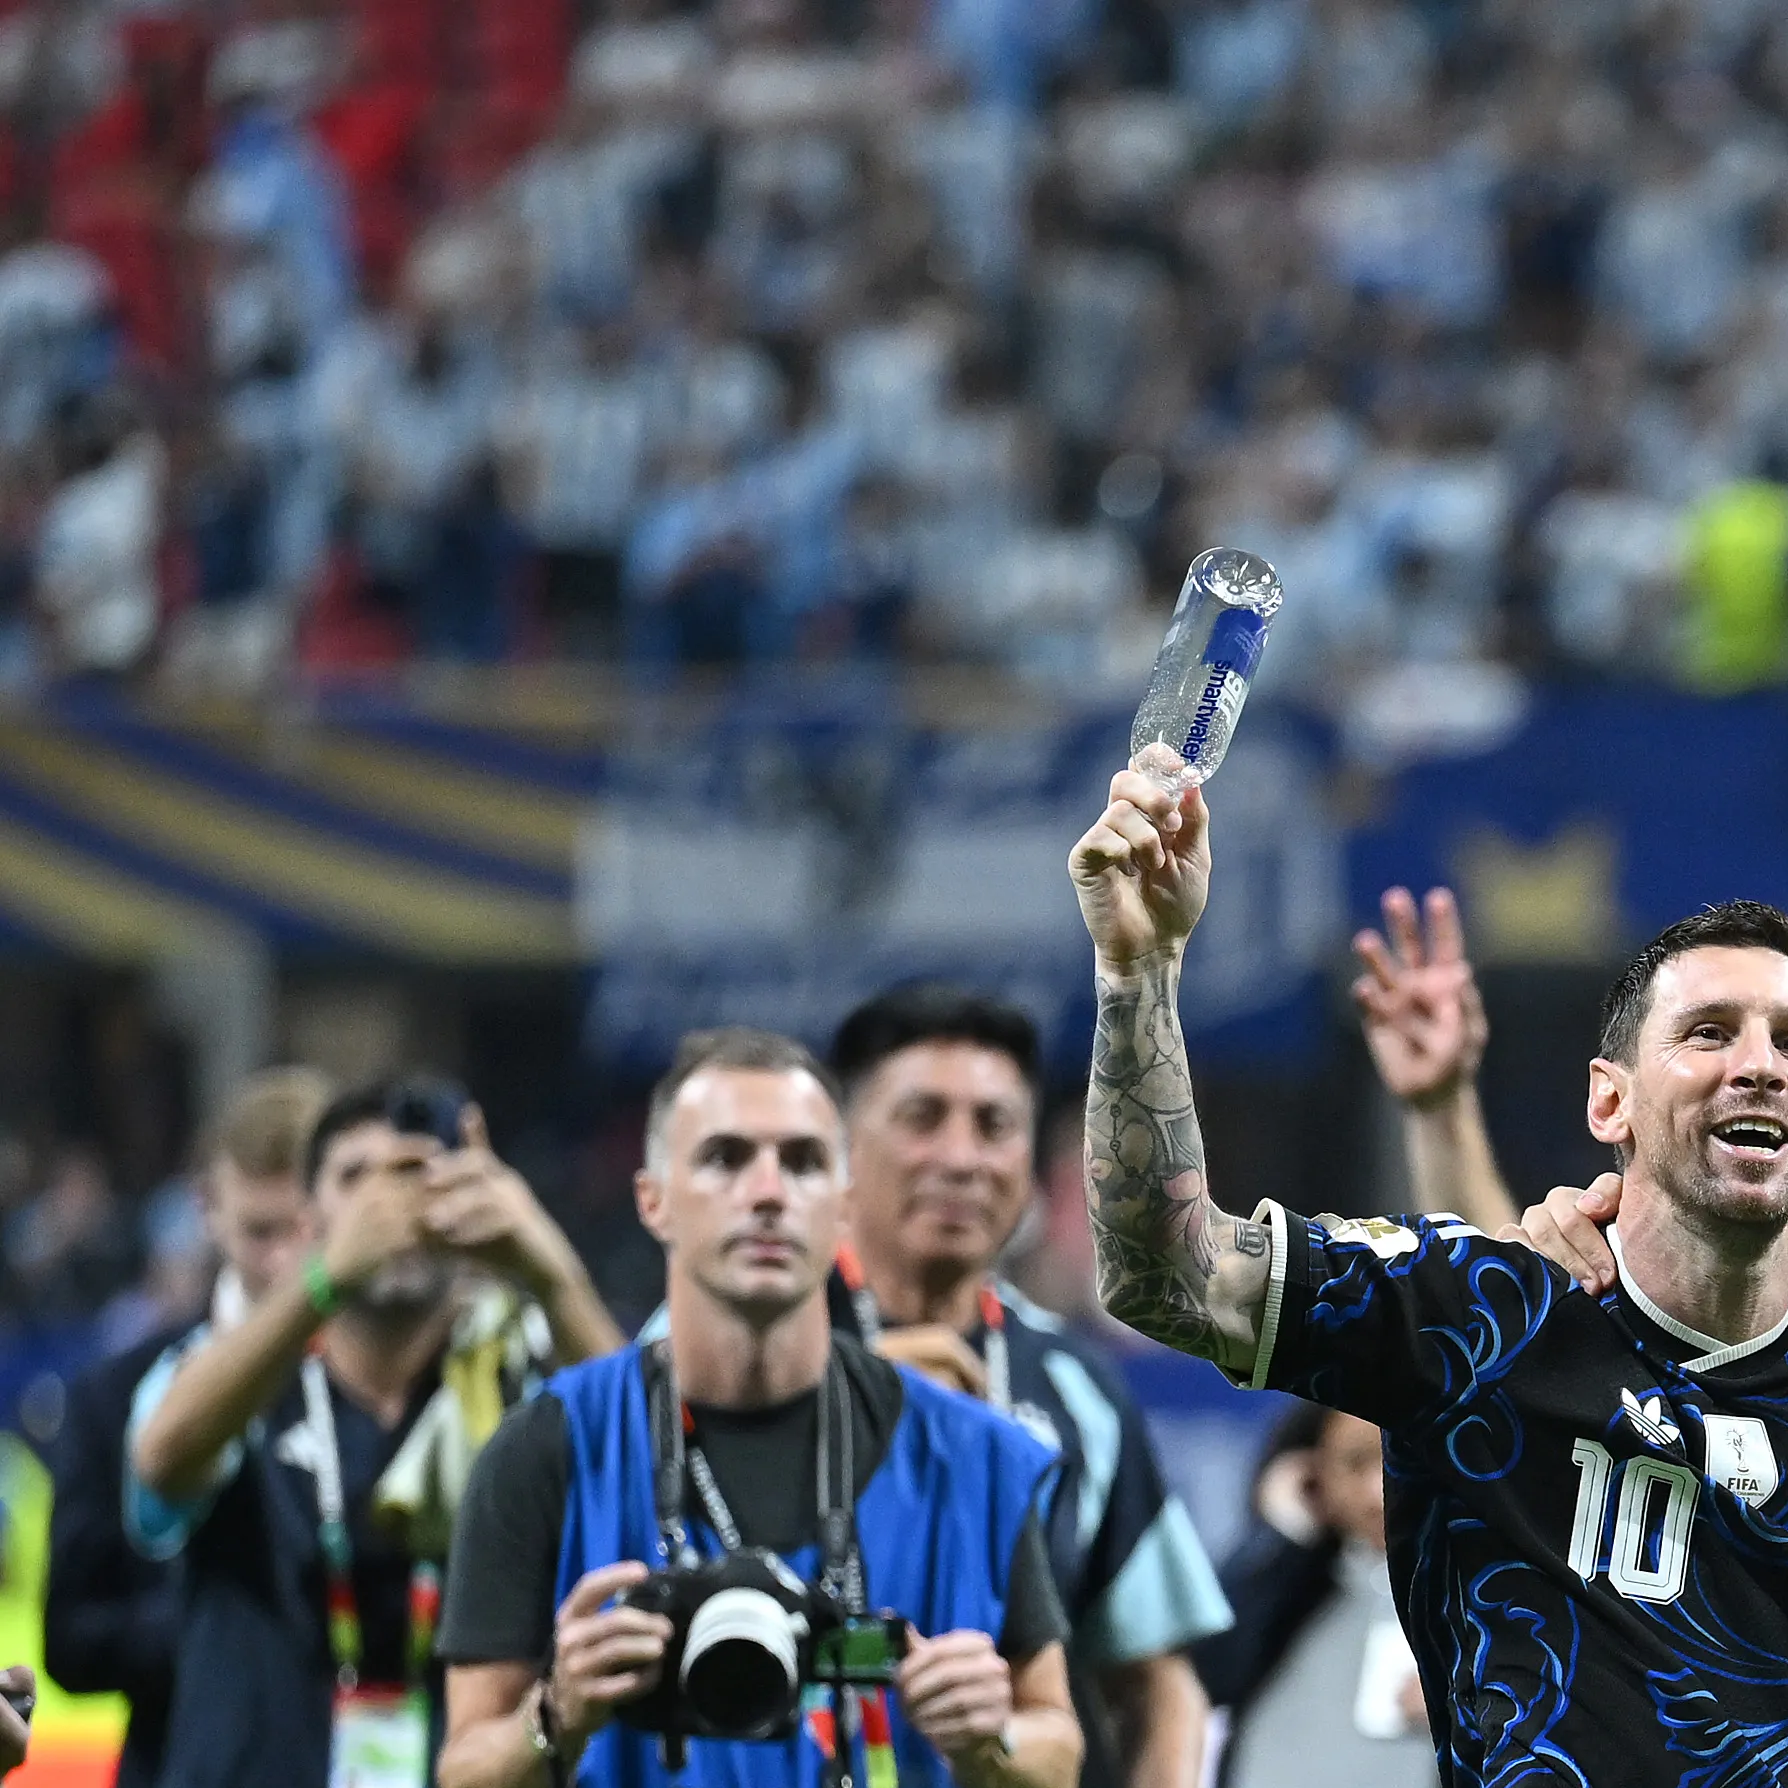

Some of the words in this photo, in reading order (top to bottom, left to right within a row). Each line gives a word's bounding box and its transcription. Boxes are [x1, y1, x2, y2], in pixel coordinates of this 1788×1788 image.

[1180, 660, 1231, 763] smartwater
[1568, 1437, 1702, 1605] 10
[1727, 1477, 1758, 1491] FIFA
